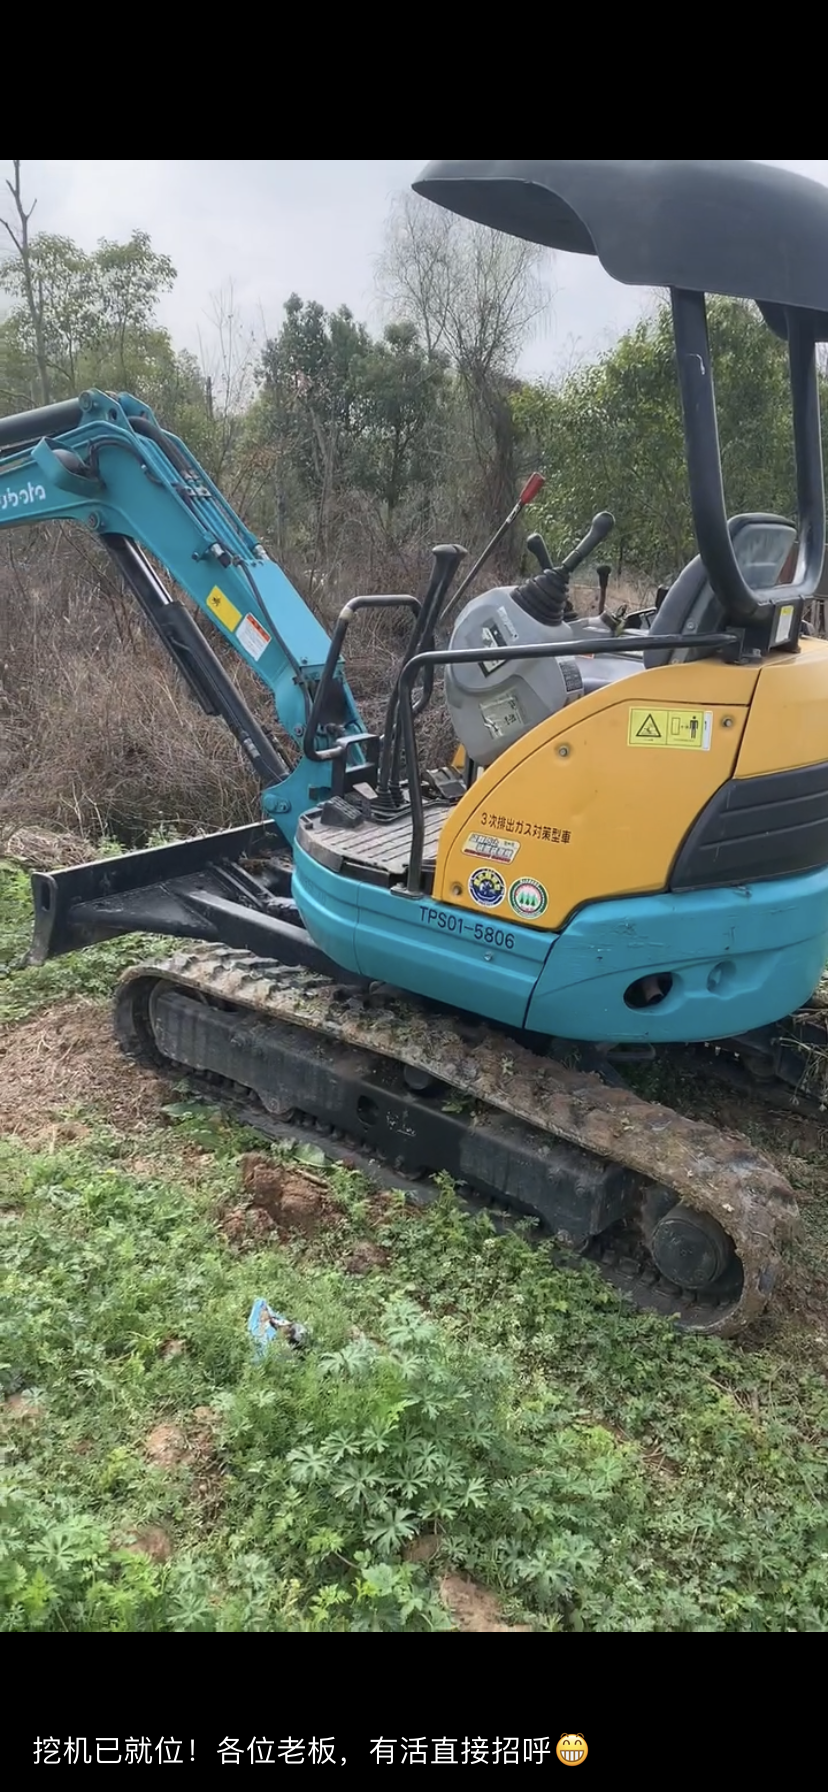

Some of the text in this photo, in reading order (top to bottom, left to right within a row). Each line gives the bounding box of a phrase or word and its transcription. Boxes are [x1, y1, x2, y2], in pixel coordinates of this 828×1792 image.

[481, 812, 572, 844] 3次排出ガス対策型車
[420, 905, 515, 949] TPS01-5806
